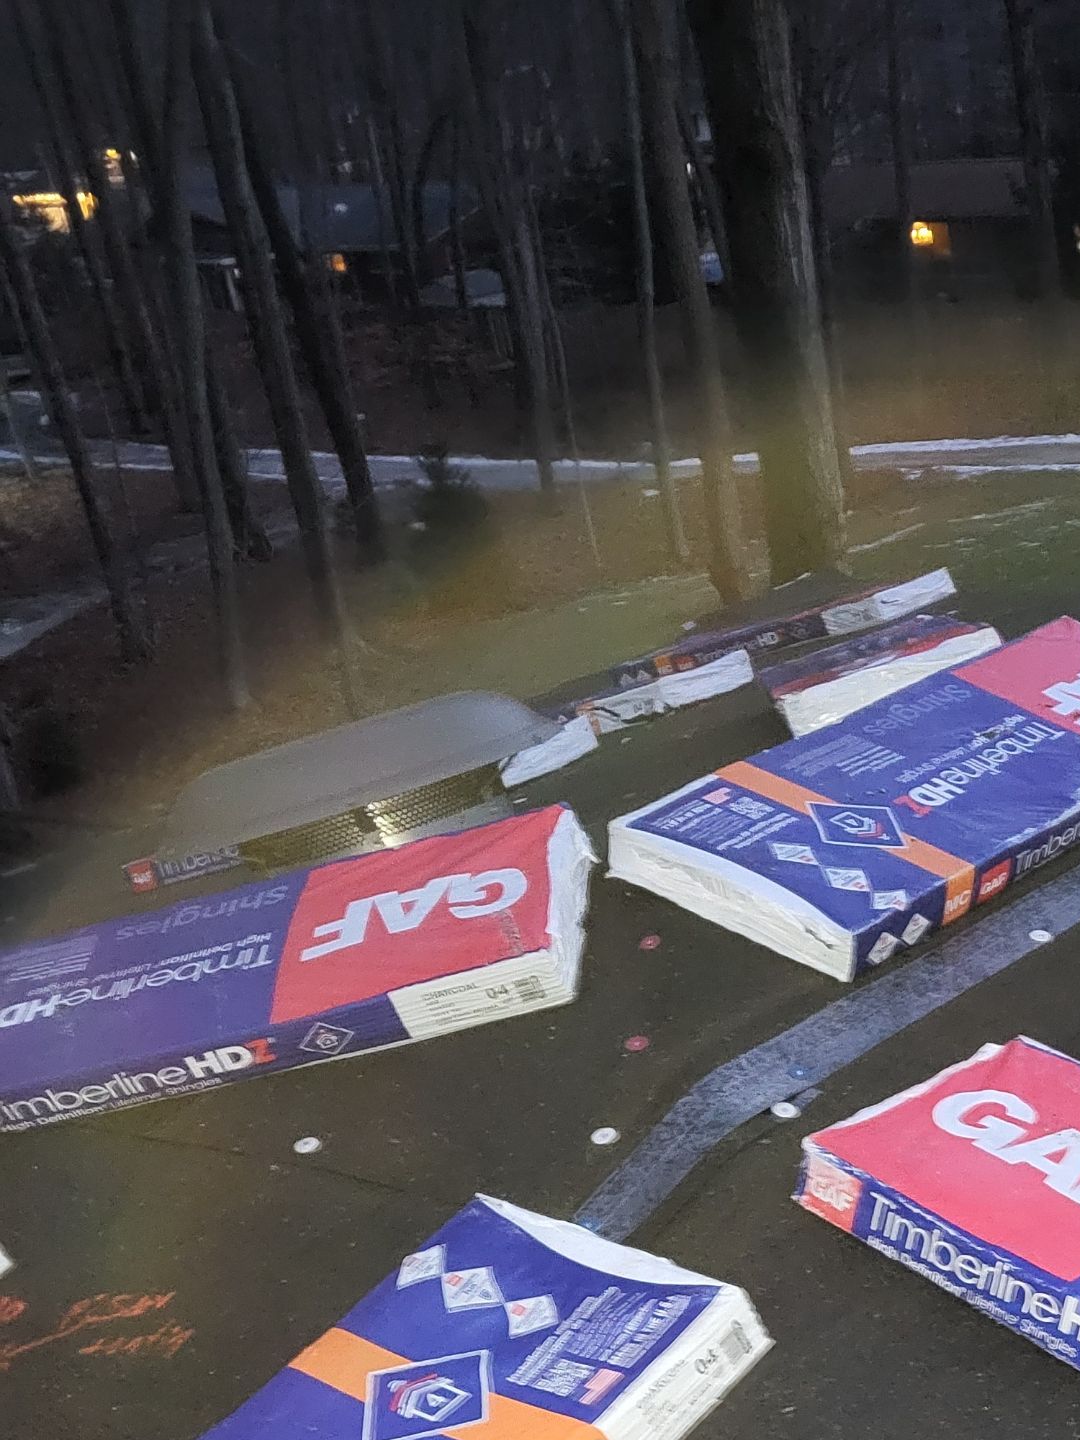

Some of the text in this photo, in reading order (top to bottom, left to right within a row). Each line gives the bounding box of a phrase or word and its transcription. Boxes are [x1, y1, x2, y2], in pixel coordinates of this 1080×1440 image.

[864, 684, 974, 739] Shingles
[980, 870, 1008, 894] GAF
[116, 884, 289, 941] Shingles
[301, 868, 528, 962] GAF
[238, 932, 272, 949] High
[165, 1076, 222, 1097] Shingles
[810, 1177, 852, 1213] GAF
[965, 1289, 1019, 1326] Lifetime
[1018, 1319, 1079, 1359] Shingles
